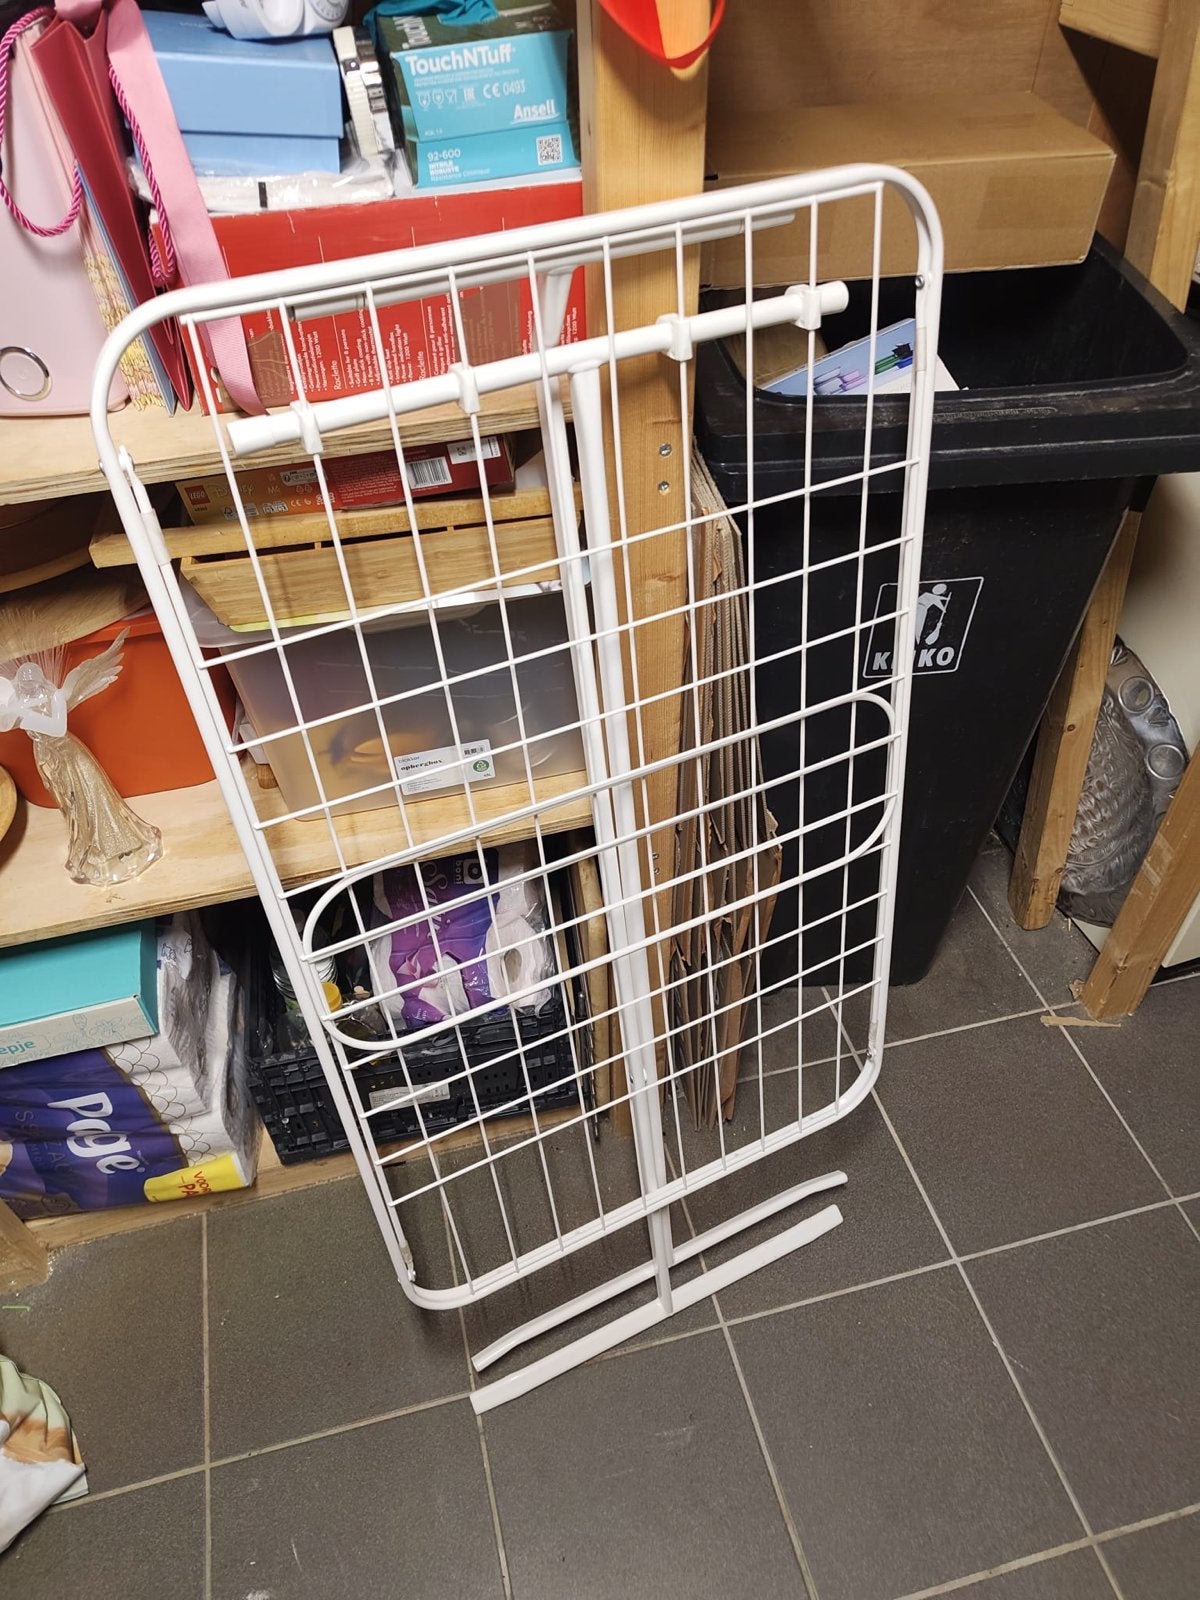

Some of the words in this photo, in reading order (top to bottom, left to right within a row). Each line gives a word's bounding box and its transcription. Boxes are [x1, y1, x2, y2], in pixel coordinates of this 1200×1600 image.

[405, 43, 513, 76] TouchNTuff
[503, 80, 526, 96] 0493
[513, 100, 557, 120] Ansell
[427, 149, 461, 162] 92-600
[189, 489, 206, 500] LEGO
[872, 646, 955, 671] KKO
[47, 1091, 141, 1175] Page
